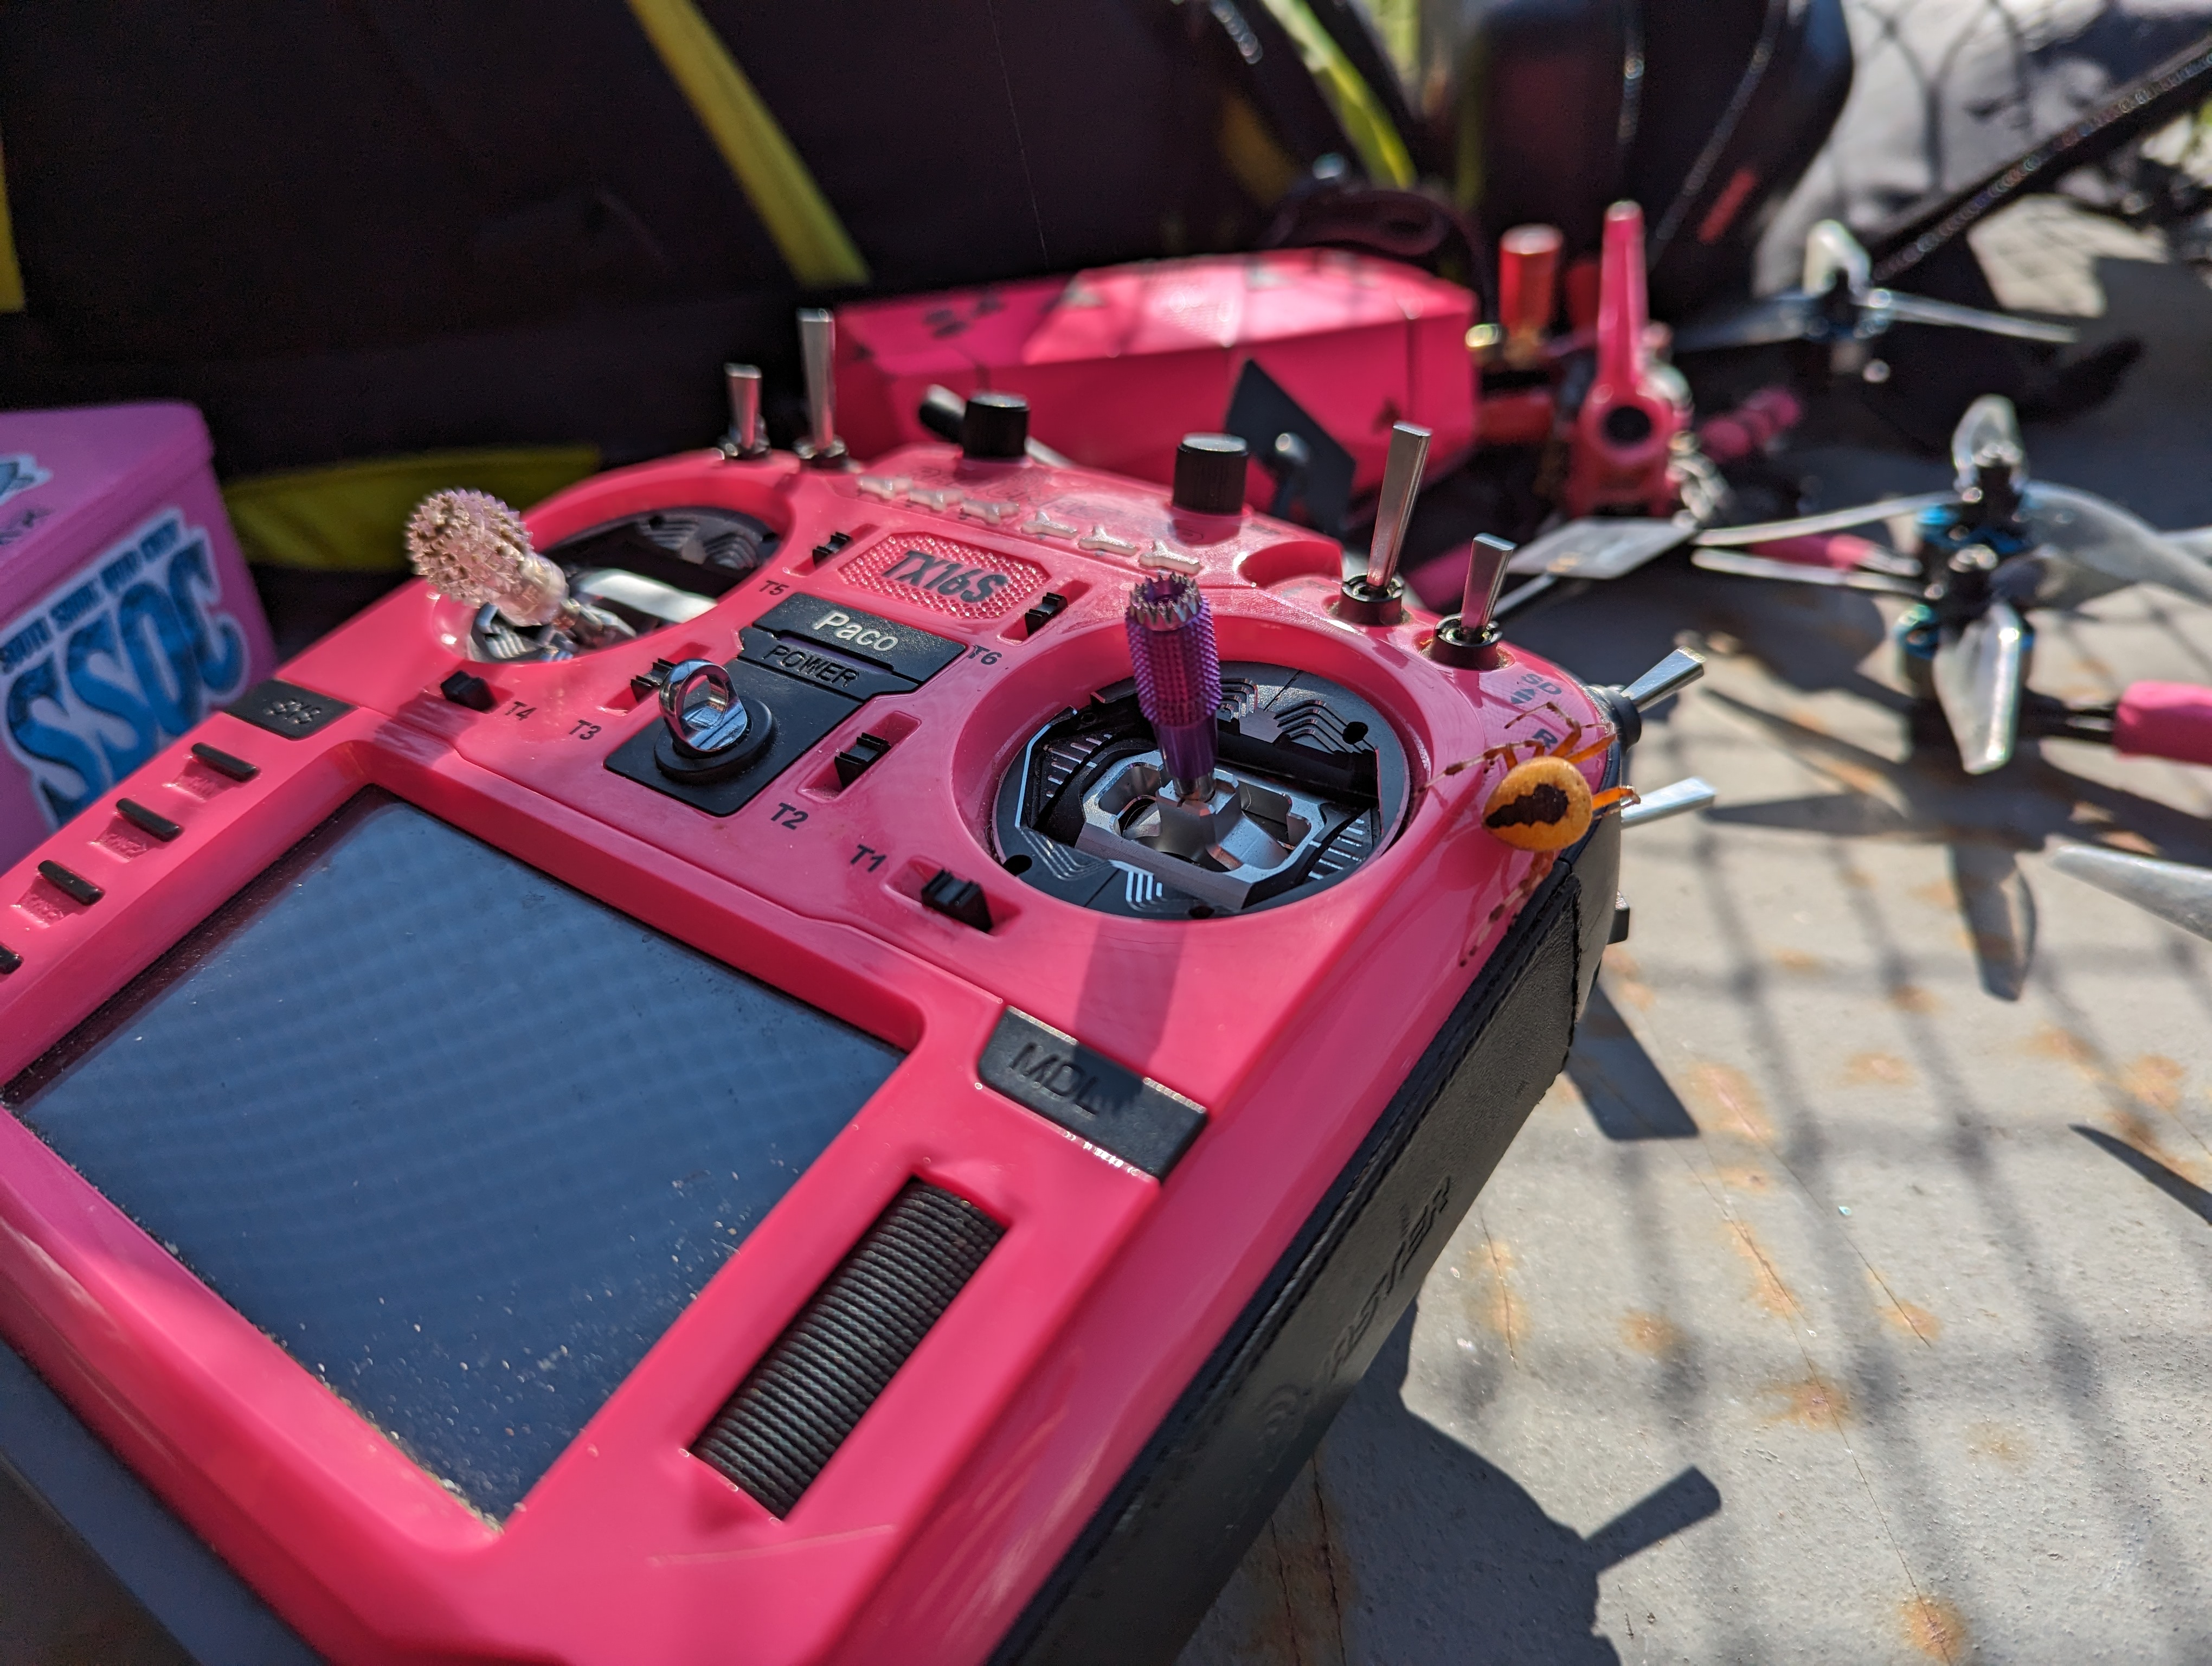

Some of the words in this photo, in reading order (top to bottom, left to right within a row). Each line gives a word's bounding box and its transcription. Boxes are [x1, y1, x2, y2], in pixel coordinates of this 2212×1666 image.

[759, 580, 790, 596] T5
[882, 550, 1009, 603] TX16S
[813, 610, 899, 651] Paco
[762, 644, 860, 688] POWER
[968, 644, 1002, 665] T6
[1520, 674, 1562, 695] SD
[505, 701, 537, 721] T4
[568, 719, 602, 740] T3
[770, 802, 809, 830] T2
[850, 843, 886, 872] T1
[1008, 1042, 1101, 1117] MDL
